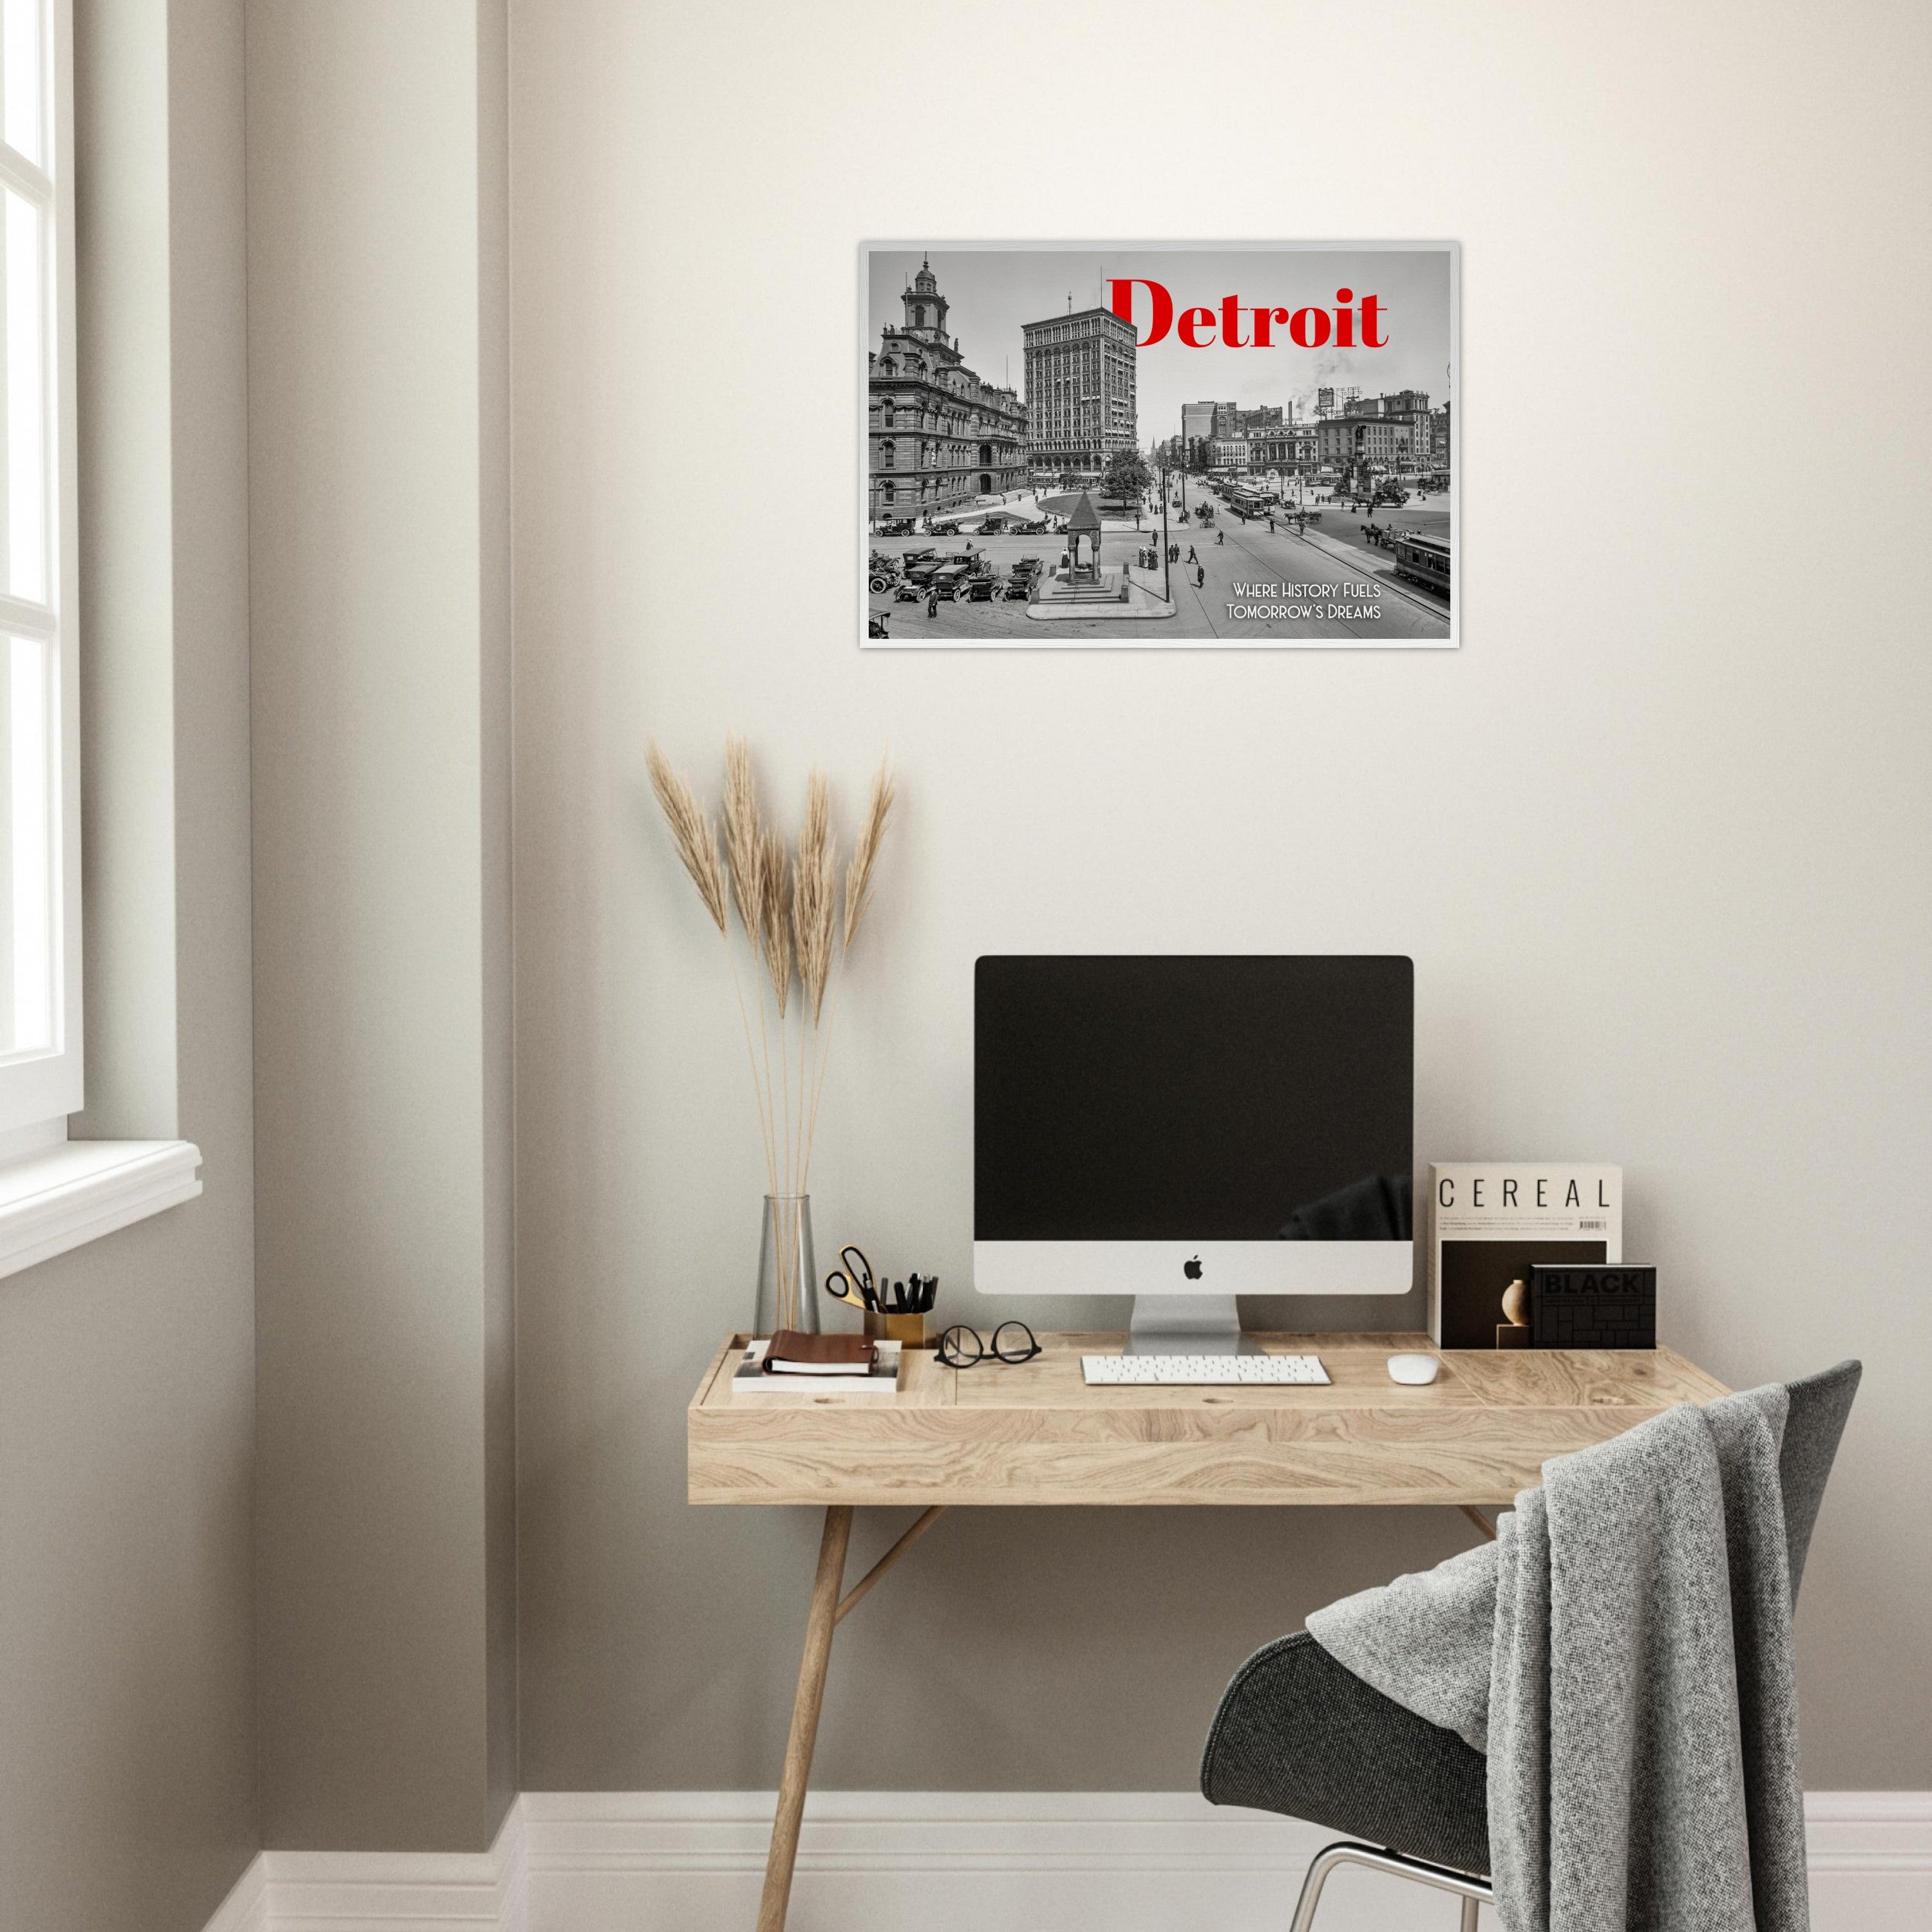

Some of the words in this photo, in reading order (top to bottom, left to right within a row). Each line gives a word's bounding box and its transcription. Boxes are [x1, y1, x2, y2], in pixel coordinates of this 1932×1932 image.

[1106, 279, 1389, 348] Detroit
[1439, 1179, 1610, 1208] CEREAL
[1545, 1273, 1641, 1294] BLACK
